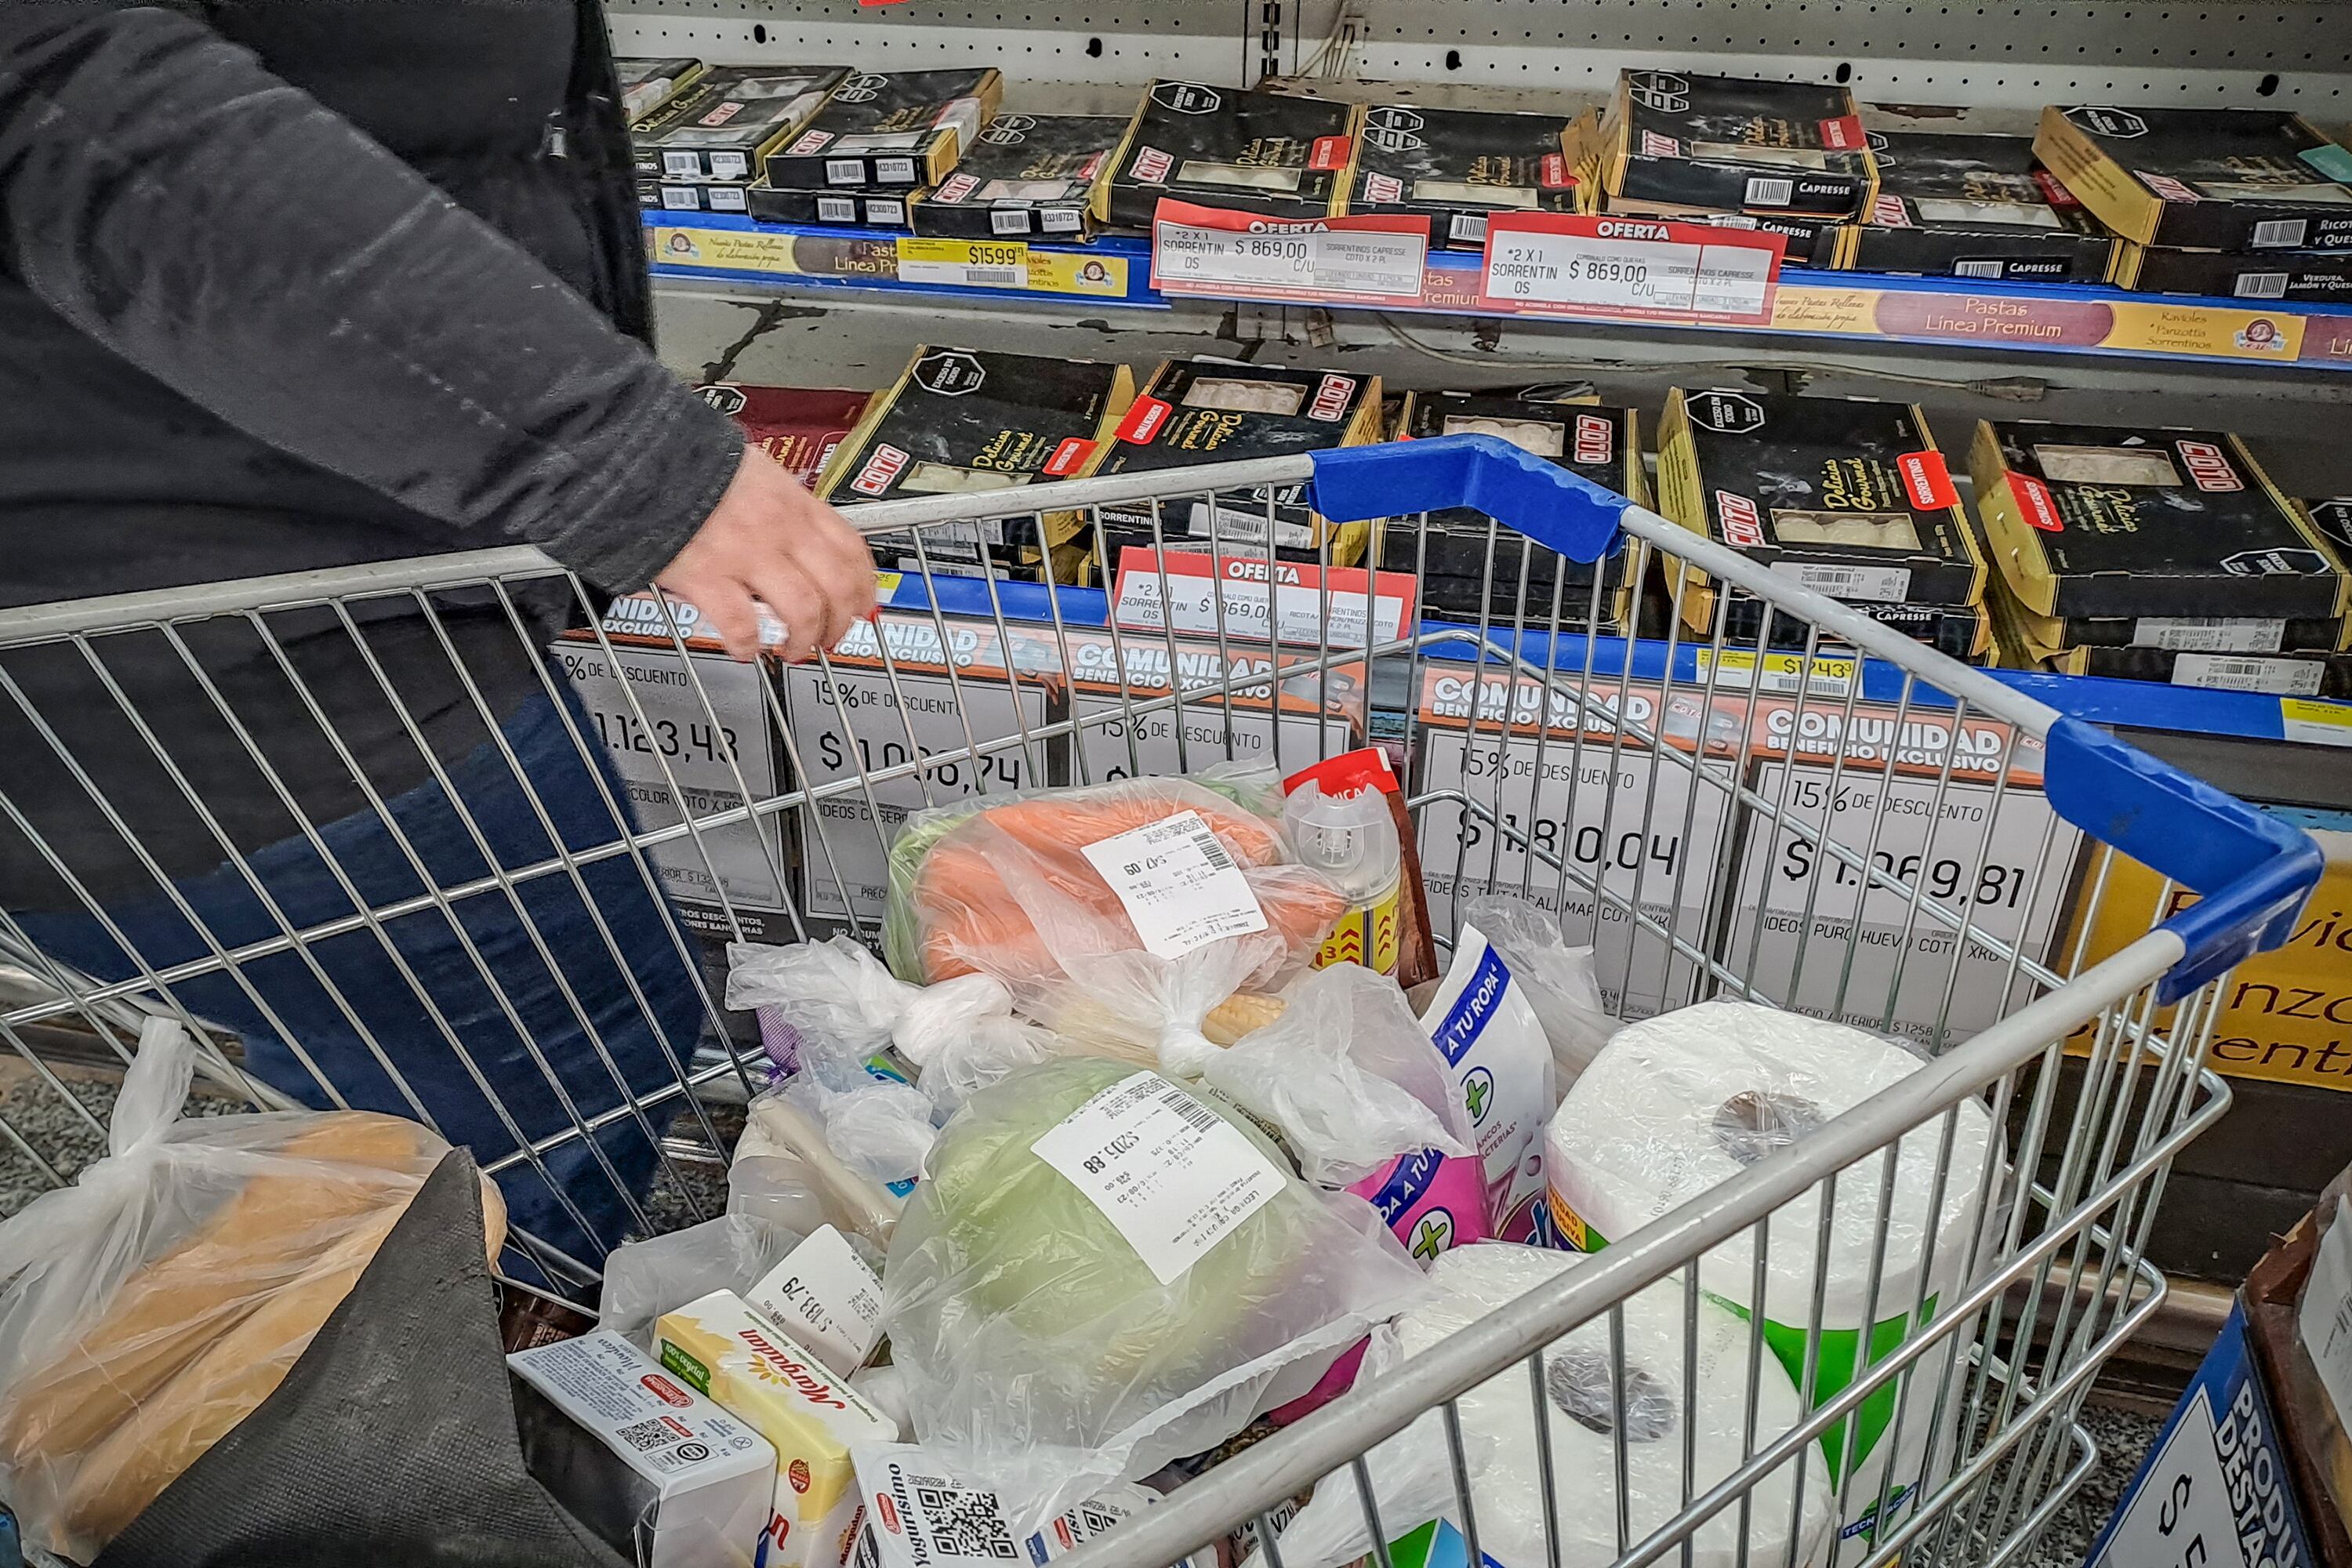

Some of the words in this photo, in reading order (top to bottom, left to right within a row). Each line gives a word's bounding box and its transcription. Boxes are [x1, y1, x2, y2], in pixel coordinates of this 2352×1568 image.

[786, 129, 835, 154] COTO
[1129, 145, 1174, 183] COTO
[931, 173, 980, 203] COTO
[1798, 181, 1850, 196] CAPRESSE
[1249, 220, 1330, 234] OFERTA
[1597, 221, 1671, 241] OFERTA
[1762, 221, 1812, 238] CAPRESSE
[1163, 240, 1225, 255] SORRENTIN
[1235, 240, 1245, 255] $
[1251, 240, 1308, 260] 869,00
[1326, 243, 1370, 254] SORRENTINOS
[1526, 249, 1534, 262] X
[1185, 256, 1200, 270] OS
[1293, 259, 1316, 273] C/U
[1492, 263, 1558, 279] SORRENTIN
[1569, 261, 1579, 280] $
[1587, 263, 1647, 284] 869,00
[1668, 266, 1715, 277] SORRENINOS
[1718, 270, 1755, 279] CAPRESSE
[2009, 263, 2063, 274] CAPRESSE
[1514, 281, 1530, 294] OS
[1631, 282, 1655, 296] C/U
[1965, 298, 2028, 316] Pastas
[1926, 313, 1976, 334] Línea
[1982, 318, 2062, 338] Premium
[2146, 336, 2212, 350] Sorrentinos
[2330, 338, 2352, 355] Lí
[1307, 374, 1356, 422] COTO
[1181, 410, 1218, 451] Gourmet
[1205, 414, 1242, 451] Delicias
[1573, 414, 1613, 464] COTO
[972, 430, 1012, 467] Delicias
[996, 432, 1033, 470] Gourmet
[850, 443, 910, 495] COTO
[2175, 439, 2245, 492] COTO
[1821, 458, 1847, 510] Delicias
[1849, 457, 1878, 511] Gourmet
[1099, 510, 1162, 525] SORRENTIN
[1715, 489, 1766, 547] COTO
[2077, 485, 2117, 534] Gourmet
[2103, 487, 2138, 532] Delicias
[1142, 609, 1159, 620] OS
[1199, 597, 1210, 612] $
[1876, 611, 1932, 622] CAPRESSE
[1261, 618, 1285, 629] CU
[588, 662, 604, 677] DE
[611, 664, 687, 686] DSCUENTO
[1077, 643, 1272, 683] COMUNIDAD
[812, 679, 859, 709] 15%
[862, 690, 878, 706] DE
[884, 693, 962, 717] DSCUENT
[1433, 702, 1534, 724] BENFICIO
[1152, 722, 1169, 738] DE
[1176, 724, 1261, 750] ESCUNTO
[1767, 709, 2002, 756] COMUNIDAD
[820, 731, 843, 771] $
[1460, 747, 1511, 779] 15%
[1513, 760, 1534, 776] DE
[1541, 764, 1635, 789] DESUENTO
[1793, 780, 1850, 812] 15%
[1853, 793, 1875, 809] DE
[1457, 809, 1482, 849] $
[1504, 813, 1679, 876] 1.80,04
[1783, 837, 1813, 880] $
[1424, 879, 1469, 898] FIDES
[702, 912, 765, 927] DESCNTOS,
[1446, 1039, 1460, 1057] A
[1454, 1014, 1474, 1041] TU
[1402, 1182, 1414, 1198] A
[665, 1342, 682, 1360] 100%
[681, 1354, 706, 1381] vegetal
[737, 1328, 846, 1410] Margadan
[888, 1463, 932, 1567] Yogurísimo
